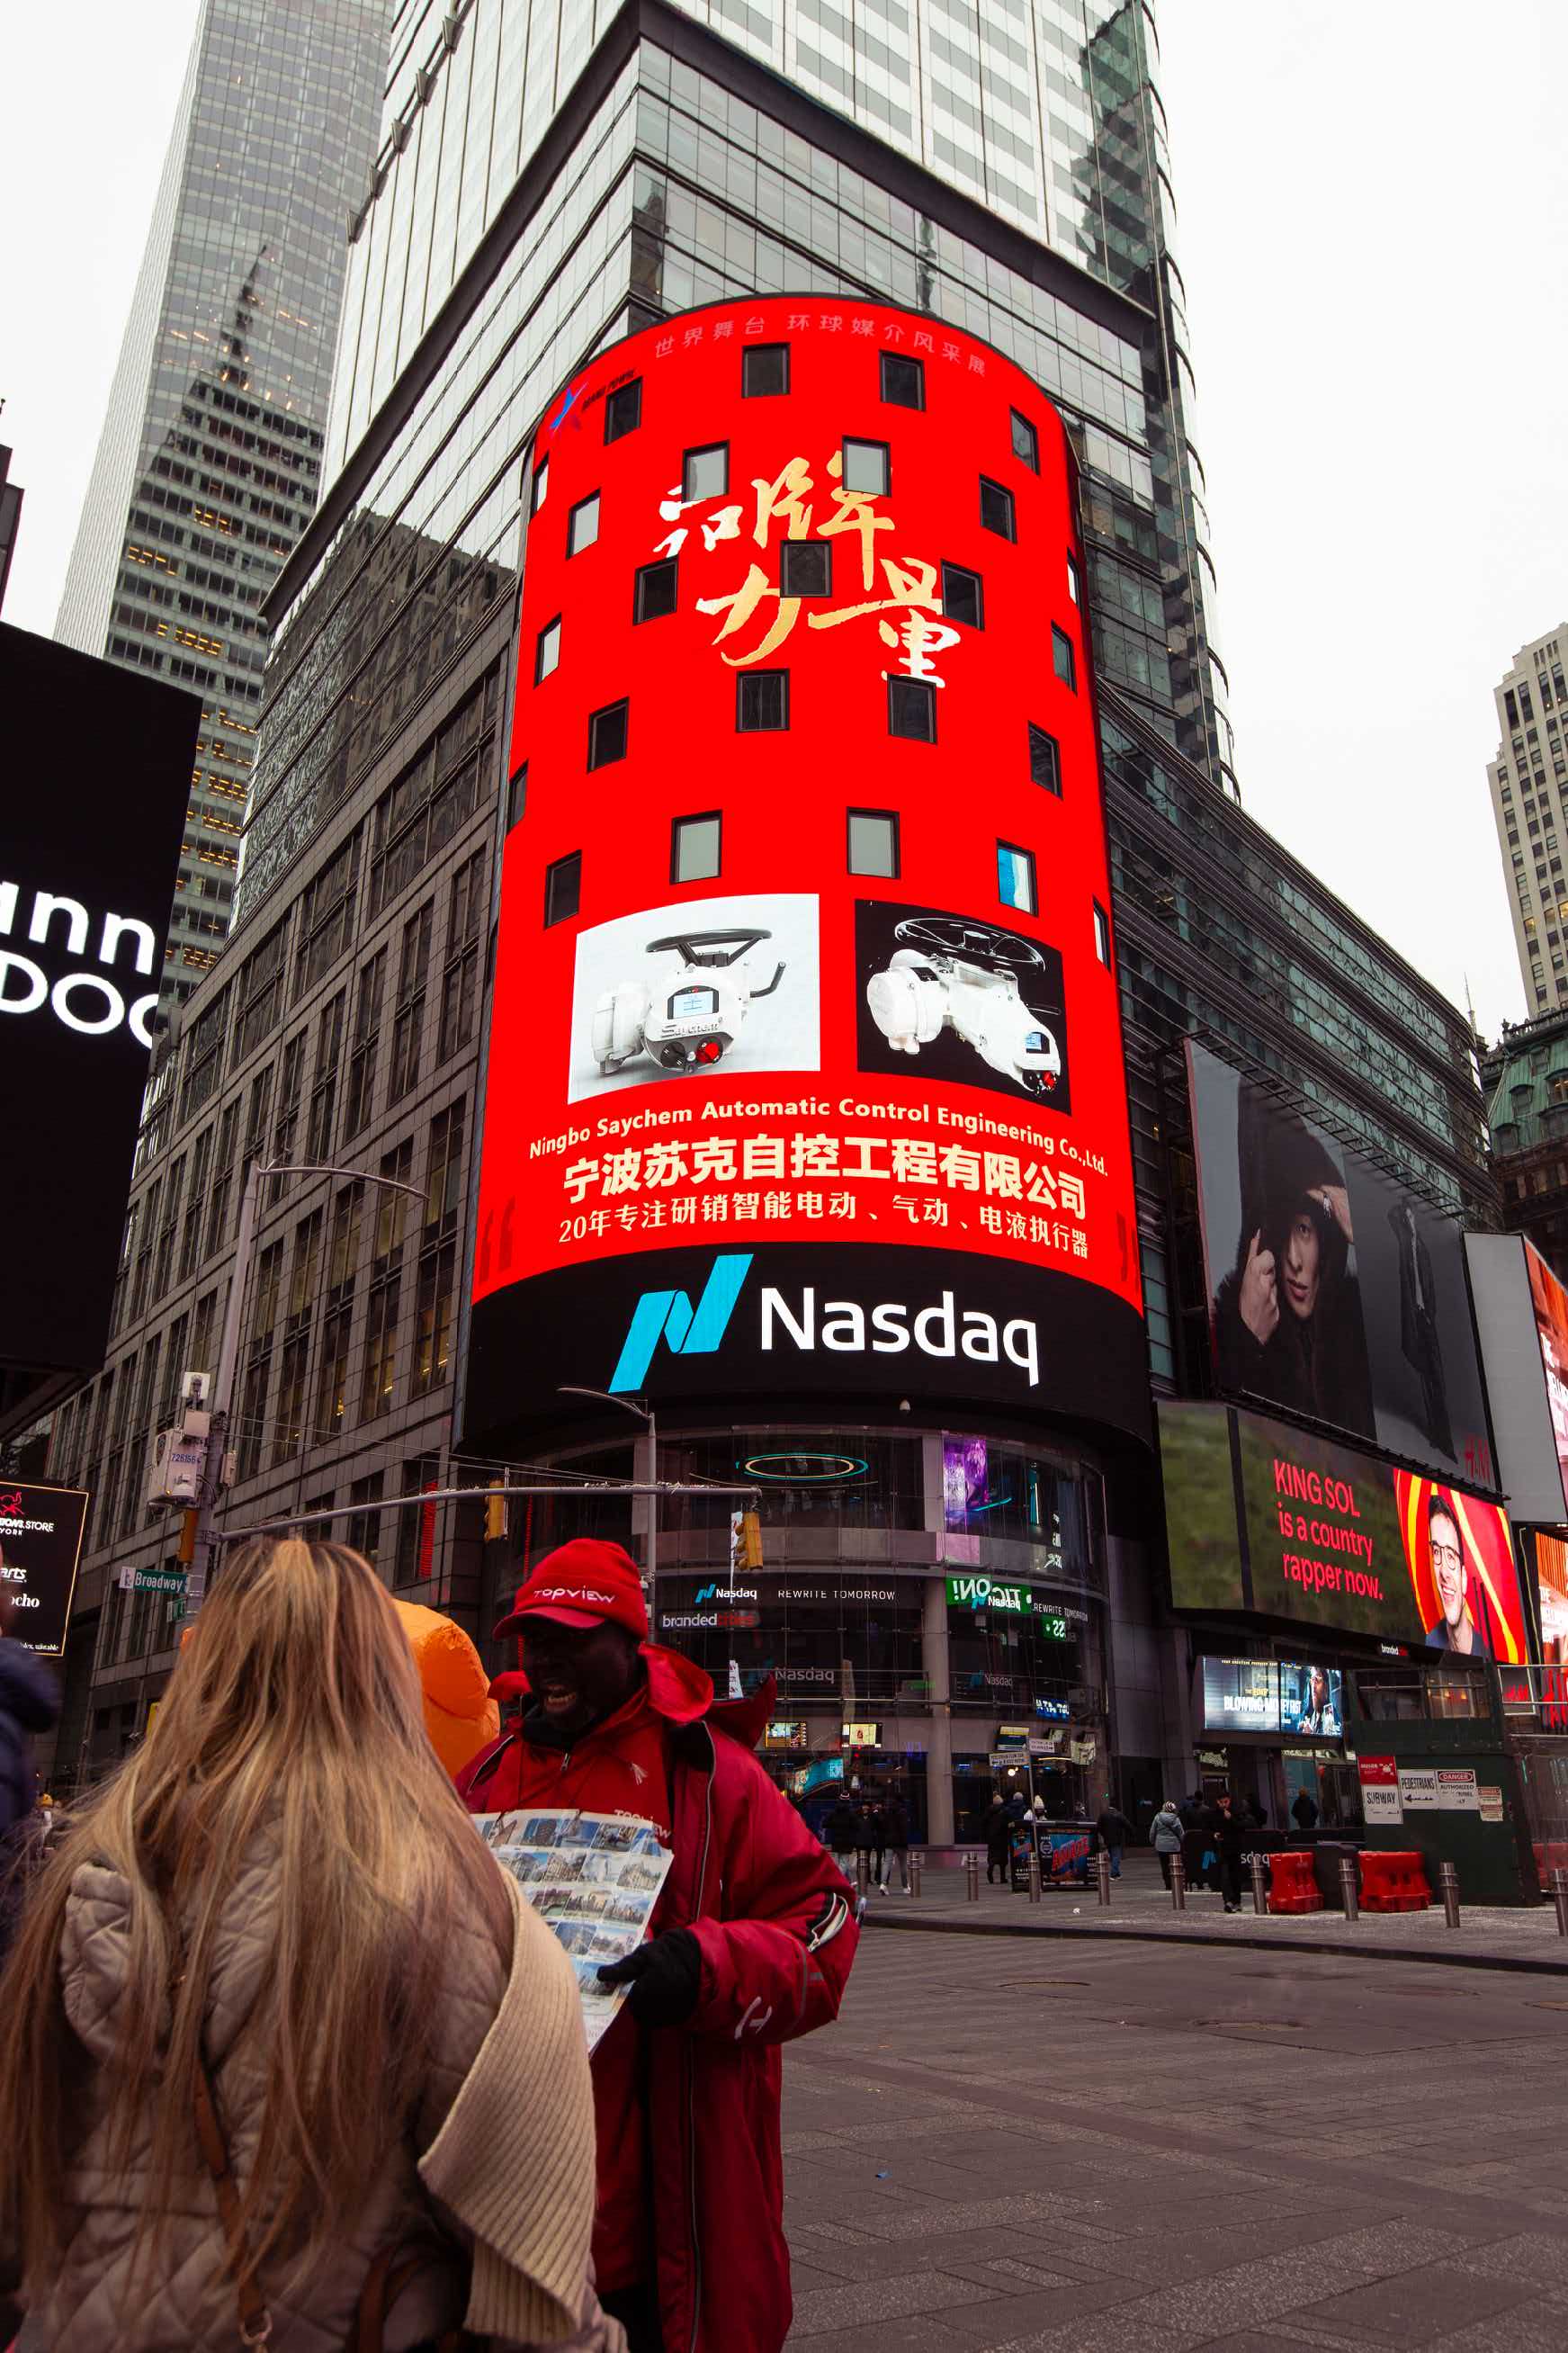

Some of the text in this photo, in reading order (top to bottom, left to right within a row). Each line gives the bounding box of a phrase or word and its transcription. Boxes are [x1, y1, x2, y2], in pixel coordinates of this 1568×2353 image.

[529, 1125, 591, 1159] Ningbo
[596, 1108, 693, 1138] Saychem
[701, 1096, 830, 1120] Automatic
[838, 1098, 929, 1123] Control
[937, 1107, 1054, 1155] Engineering
[563, 1132, 1087, 1220] 宁波苏克自控工程有限公司
[760, 1288, 1040, 1387] Nasdaq
[1274, 1459, 1360, 1517] KING SOL
[1277, 1501, 1373, 1567] is a country
[135, 1571, 183, 1593] Broadway
[1283, 1553, 1384, 1600] rapper now.
[716, 1588, 757, 1600] Nasdaq
[778, 1590, 896, 1601] REWRITE TOMORROW
[775, 1666, 835, 1684] Nasdaq
[1366, 1792, 1395, 1804] SUBWAY
[1401, 1777, 1435, 1790] PEDESTRIANS
